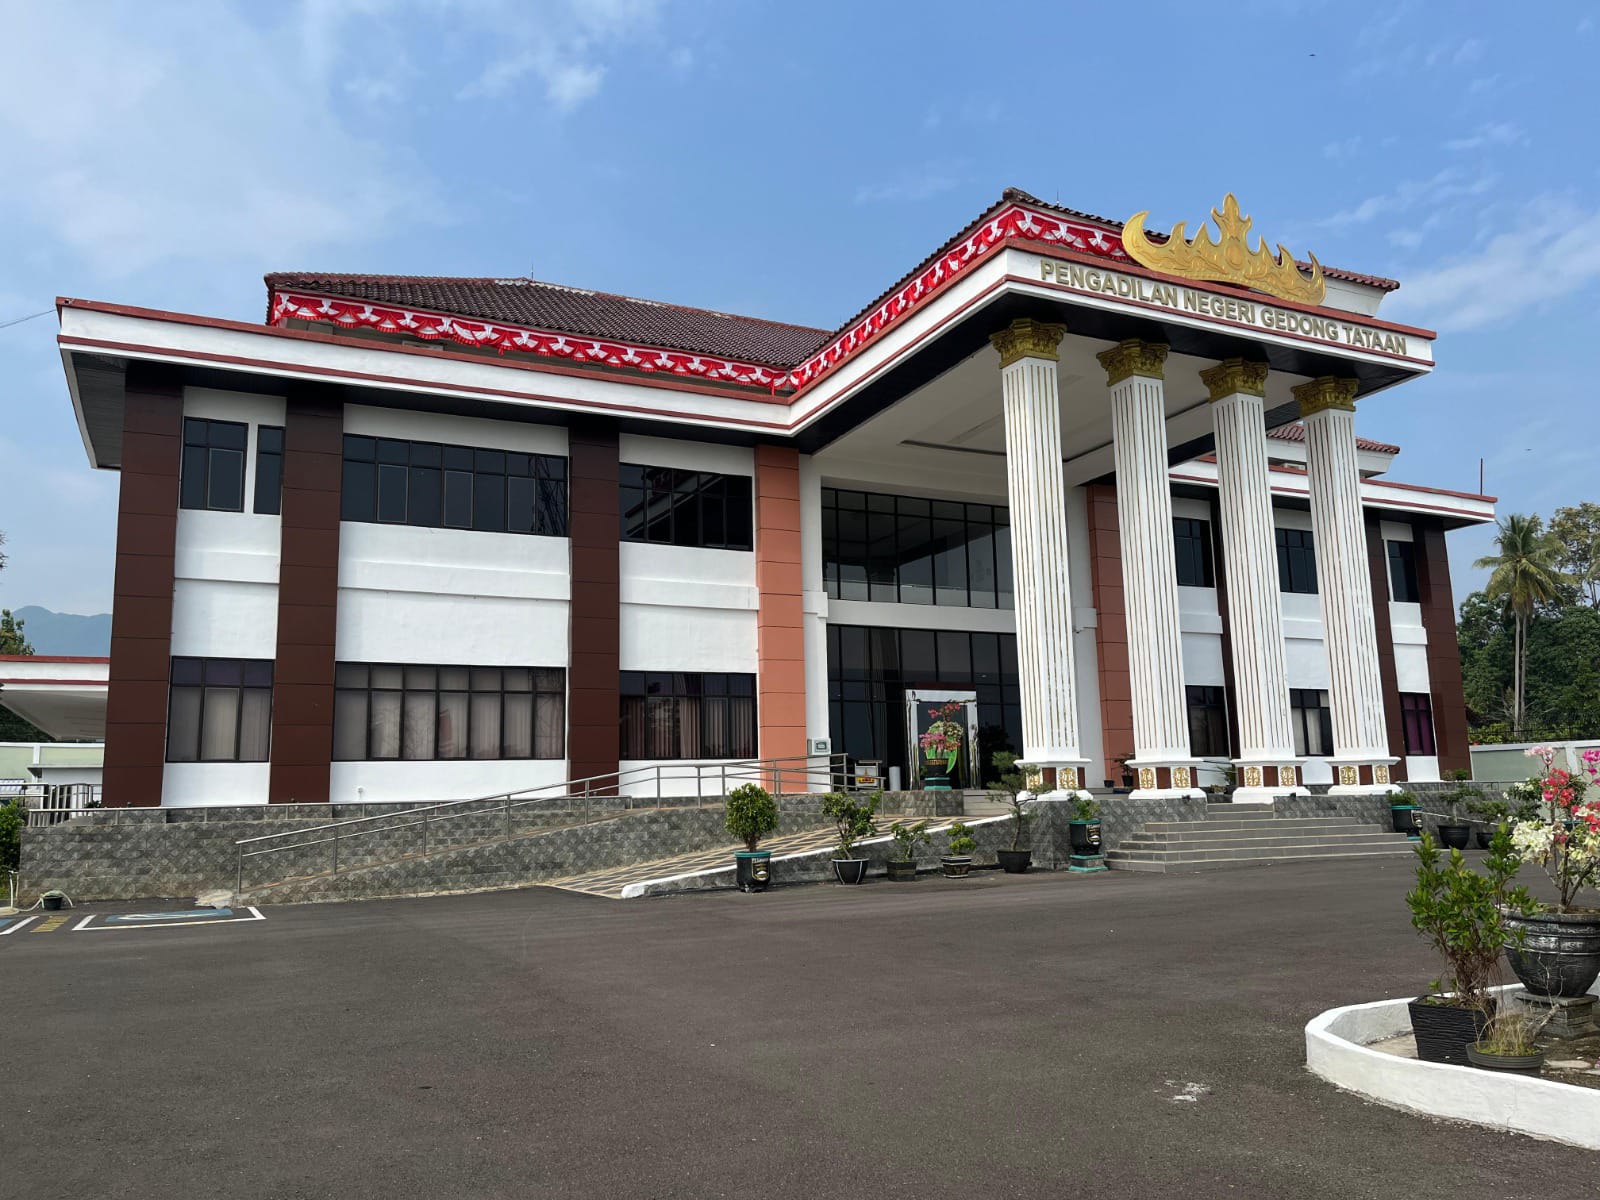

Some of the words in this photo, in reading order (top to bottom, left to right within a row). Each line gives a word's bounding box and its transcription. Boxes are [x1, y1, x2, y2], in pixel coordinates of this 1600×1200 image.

[1040, 259, 1178, 307] PENGADILAN
[1184, 289, 1255, 324] NEGERI
[1260, 307, 1339, 341] GEDONG
[1342, 325, 1407, 355] TATAAN
